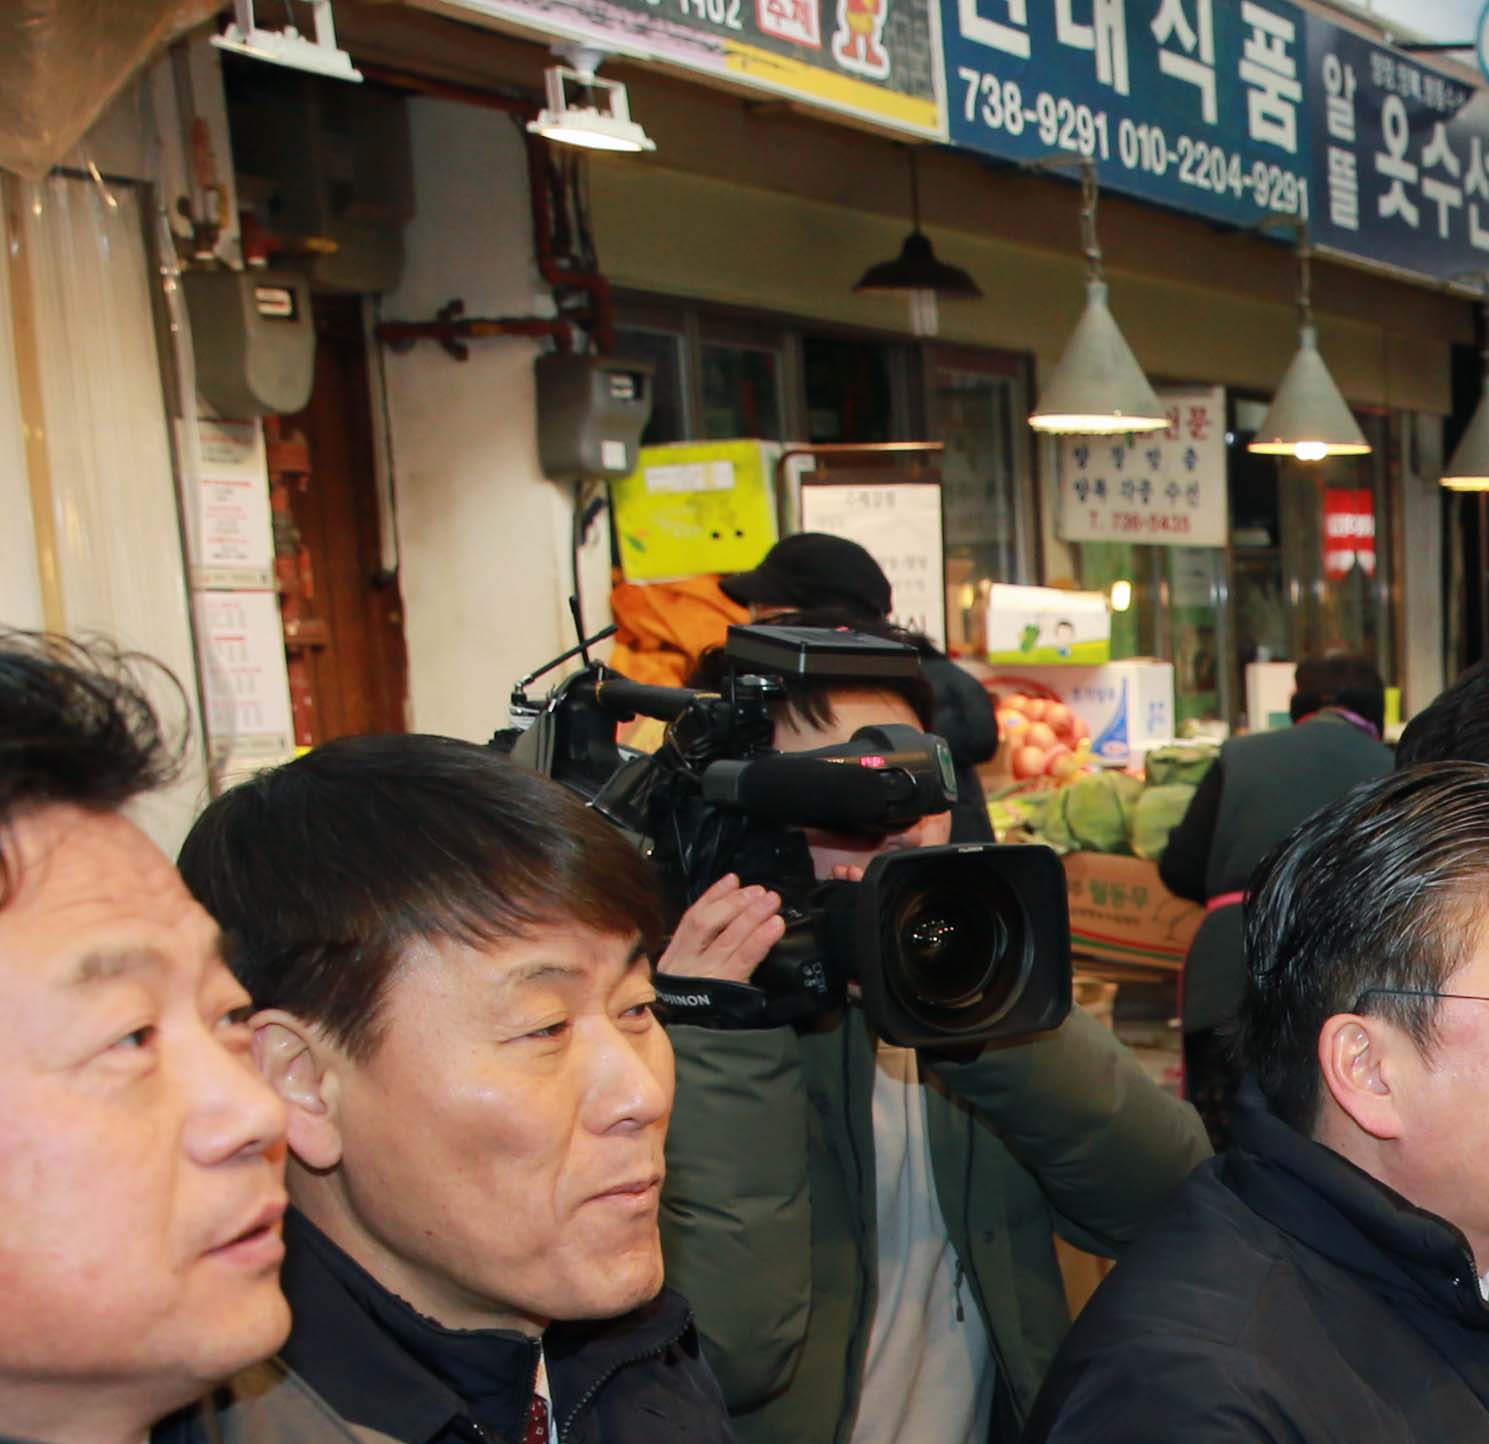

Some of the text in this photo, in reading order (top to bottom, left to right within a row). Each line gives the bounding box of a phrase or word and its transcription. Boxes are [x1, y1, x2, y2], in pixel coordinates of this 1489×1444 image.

[958, 66, 1310, 221] 738-9291 010-2204-9291
[1321, 53, 1359, 231] 알뜰
